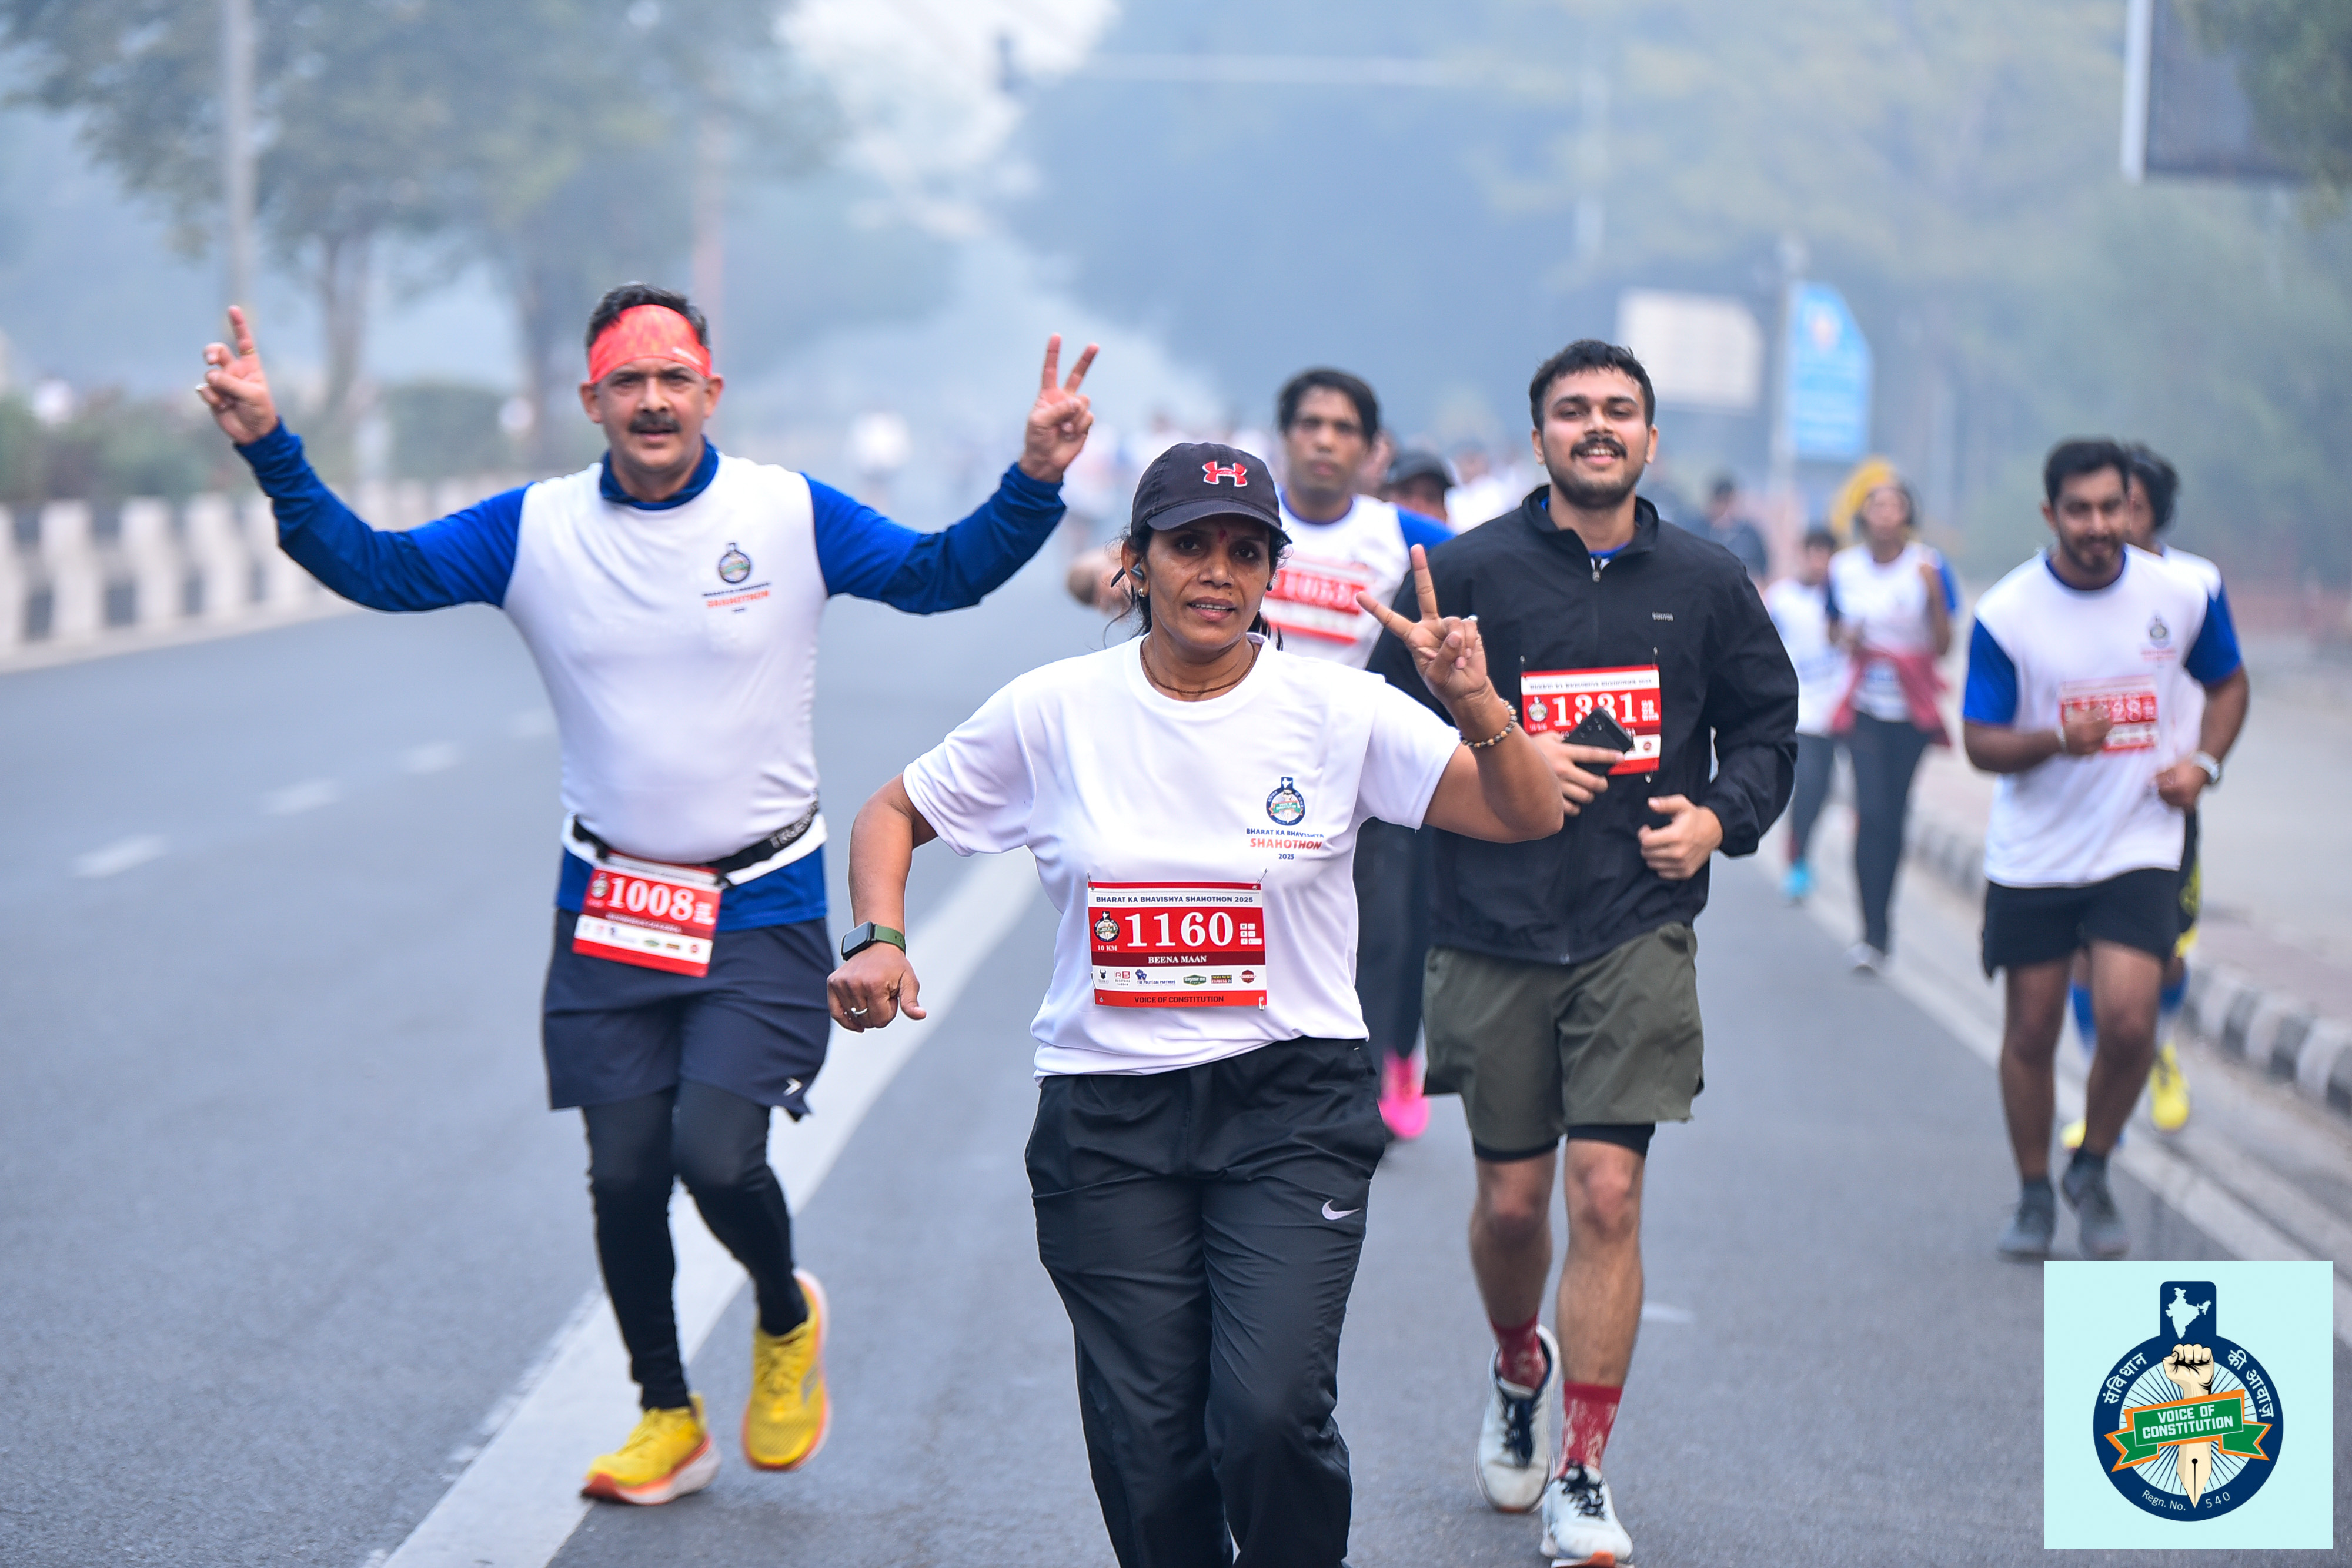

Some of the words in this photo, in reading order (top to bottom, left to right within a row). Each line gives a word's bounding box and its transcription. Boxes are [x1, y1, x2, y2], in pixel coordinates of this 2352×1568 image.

[1250, 838, 1322, 850] SHAHOTHON
[606, 877, 695, 921] 1008
[1124, 911, 1234, 947] 1160
